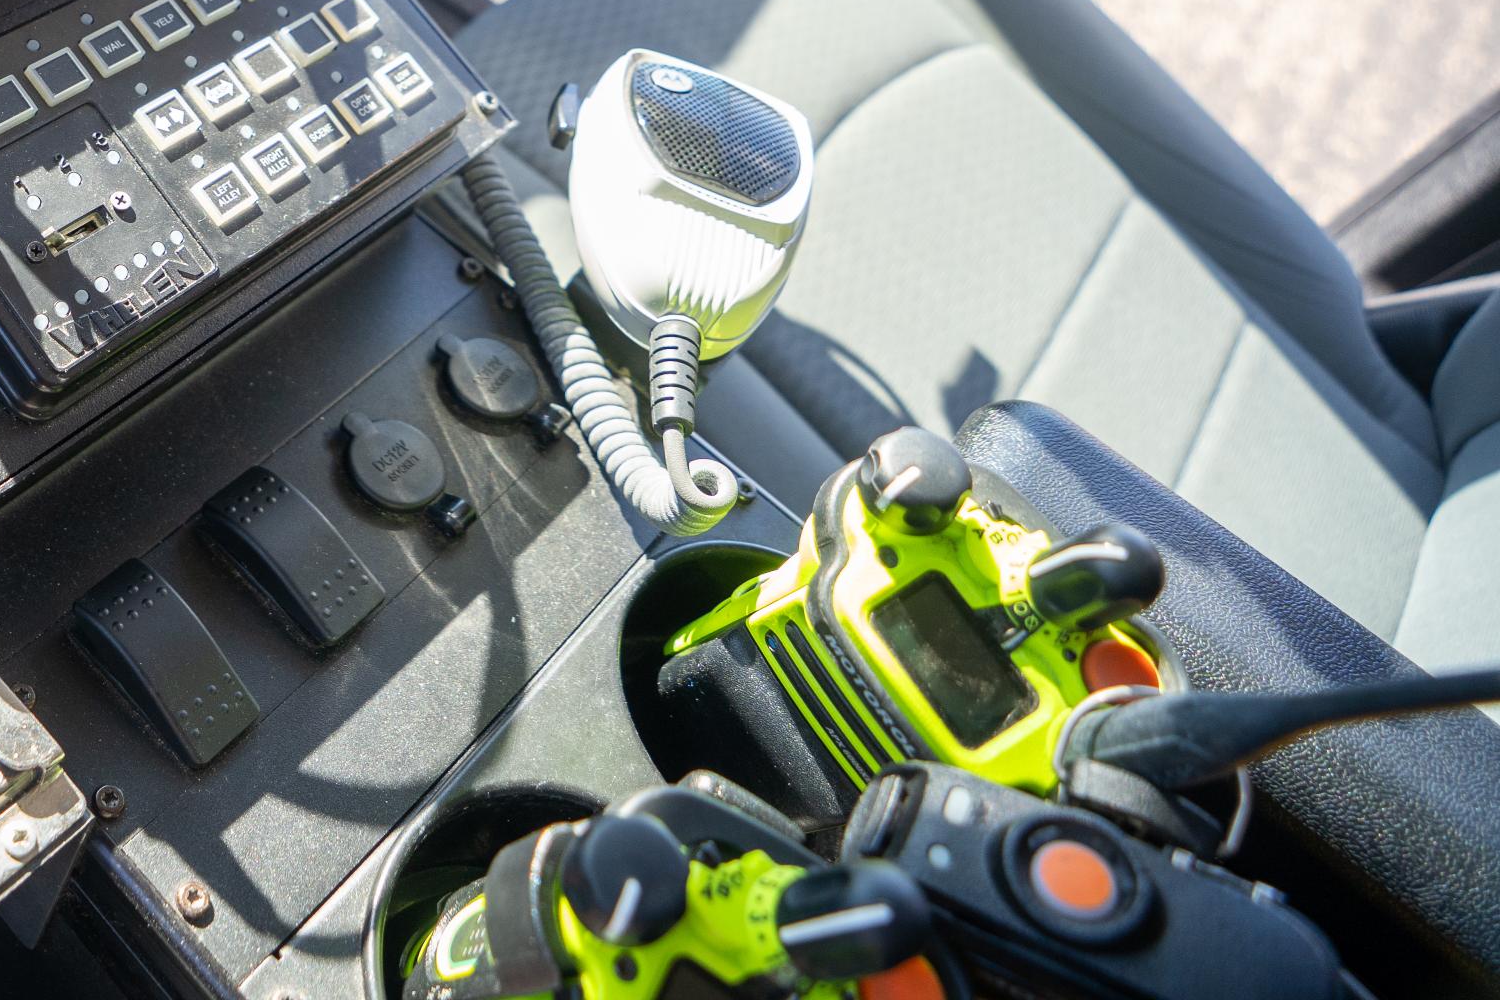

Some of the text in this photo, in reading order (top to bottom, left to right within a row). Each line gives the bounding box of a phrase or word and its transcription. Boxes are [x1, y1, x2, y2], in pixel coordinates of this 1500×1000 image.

[153, 13, 176, 29] YELP
[101, 39, 126, 56] WAIL
[358, 101, 378, 116] COM
[308, 122, 335, 143] SCENE
[55, 153, 72, 173] 2
[259, 147, 285, 168] RIGHT
[267, 157, 292, 177] ALLEY
[212, 181, 232, 197] LEFT
[218, 187, 243, 207] ALLEY
[47, 244, 205, 358] WHELEN
[825, 635, 917, 758] MOTOROL
